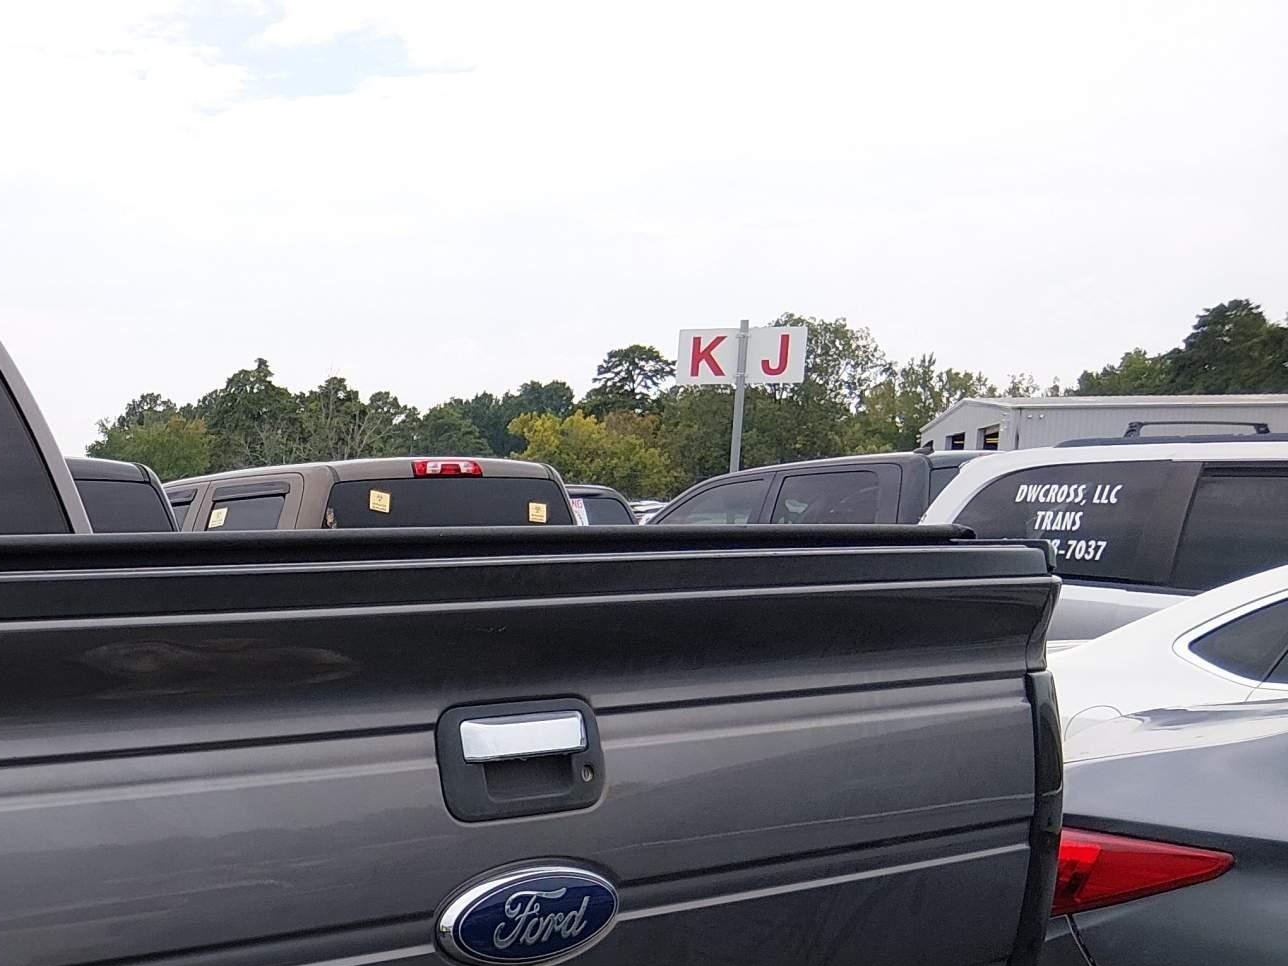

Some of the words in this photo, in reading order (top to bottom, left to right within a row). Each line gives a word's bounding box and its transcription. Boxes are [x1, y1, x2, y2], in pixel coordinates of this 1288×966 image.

[690, 335, 728, 377] K
[761, 333, 790, 376] J
[1014, 484, 1087, 506] DWCROSS,
[1092, 484, 1123, 504] LLC
[1034, 510, 1084, 531] TRANS
[493, 887, 591, 950] Ford
